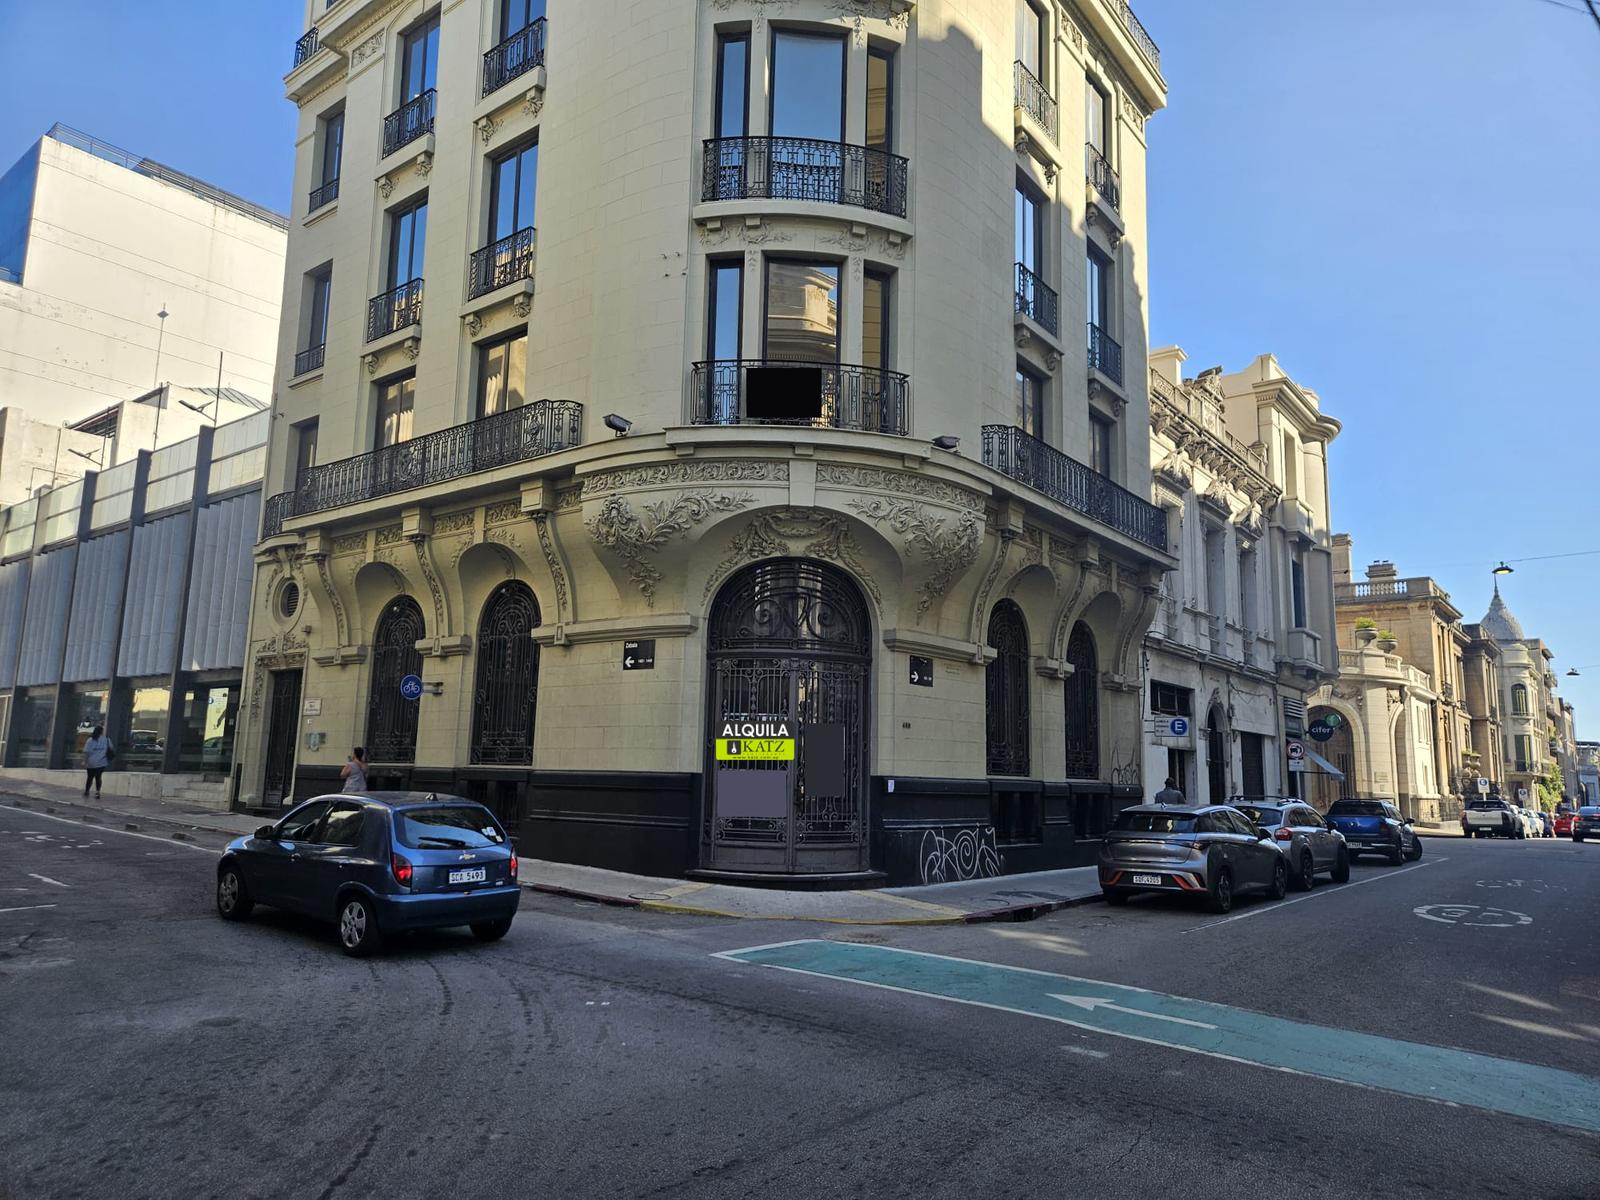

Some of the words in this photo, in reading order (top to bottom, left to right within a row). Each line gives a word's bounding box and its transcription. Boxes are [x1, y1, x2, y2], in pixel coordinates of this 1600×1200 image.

[722, 723, 789, 737] ALQUILA
[1174, 721, 1183, 731] E
[743, 740, 785, 752] KATZ
[466, 871, 484, 881] 5493
